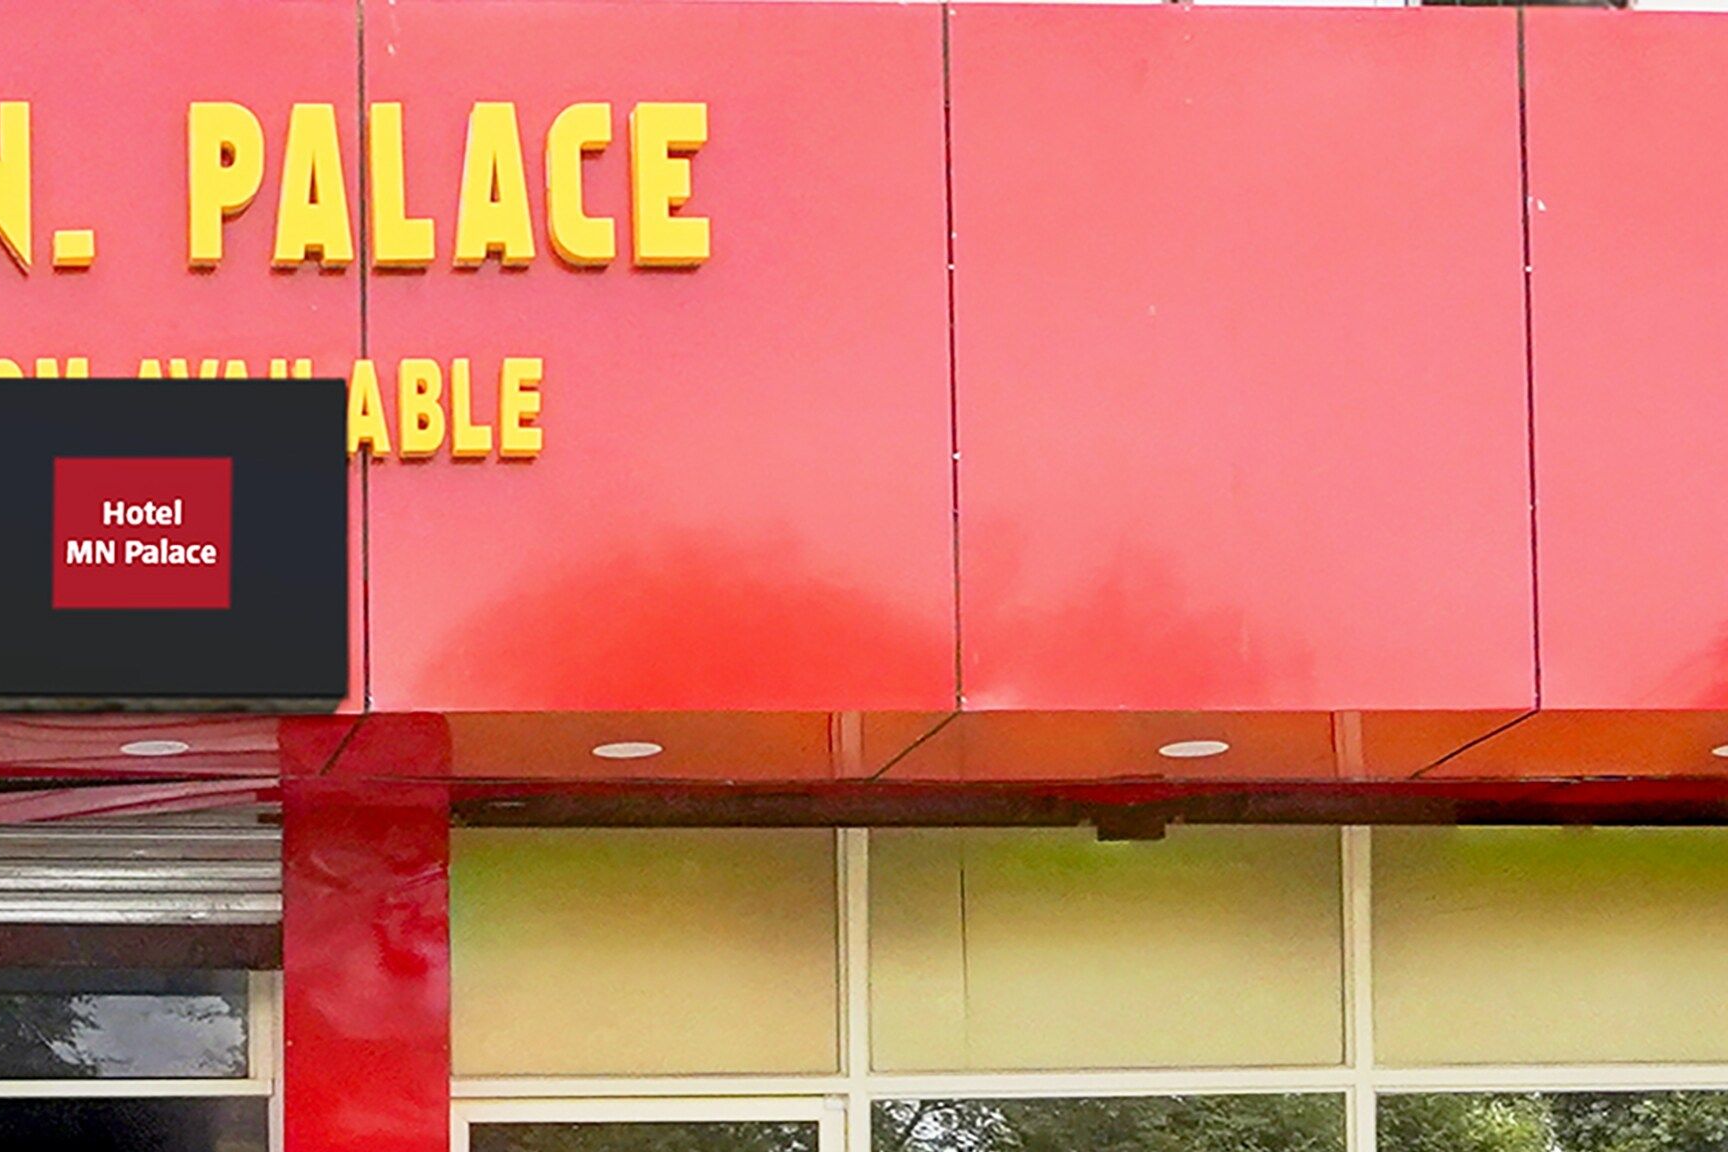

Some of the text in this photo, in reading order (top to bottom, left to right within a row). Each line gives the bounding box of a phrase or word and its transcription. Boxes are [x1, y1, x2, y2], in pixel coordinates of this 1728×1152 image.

[187, 101, 710, 270] PALACE
[103, 499, 182, 526] Hotel
[66, 538, 217, 565] MN Palace
